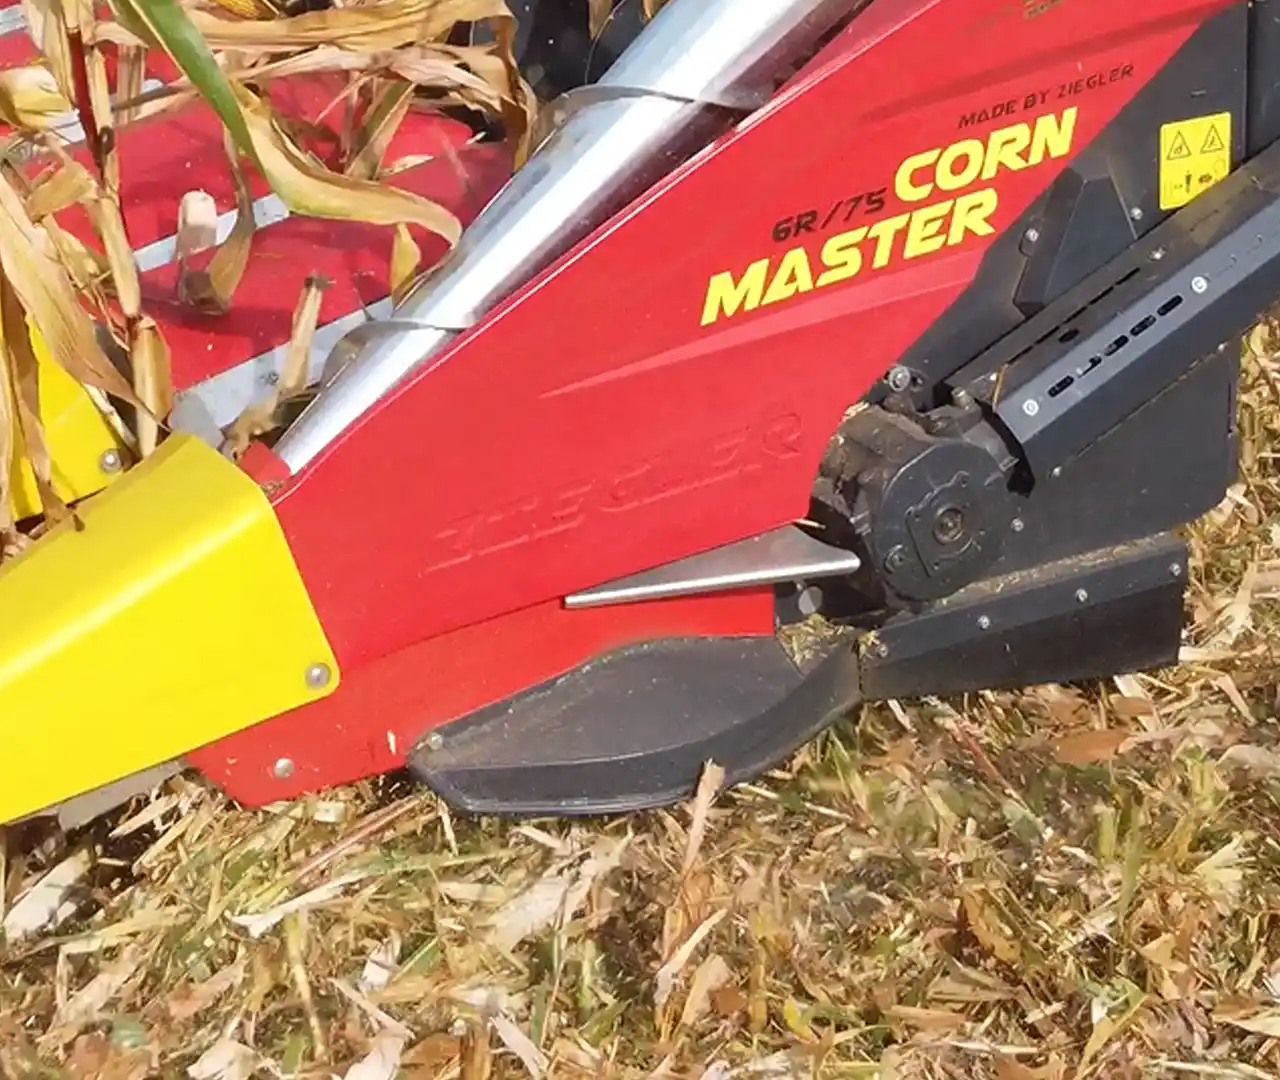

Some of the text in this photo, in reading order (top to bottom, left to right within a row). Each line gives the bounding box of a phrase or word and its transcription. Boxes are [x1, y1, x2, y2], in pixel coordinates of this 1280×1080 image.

[958, 64, 1135, 129] MADE BY ZIEGLER
[772, 107, 1078, 243] 6R/75 CORN
[700, 188, 999, 327] MASTER
